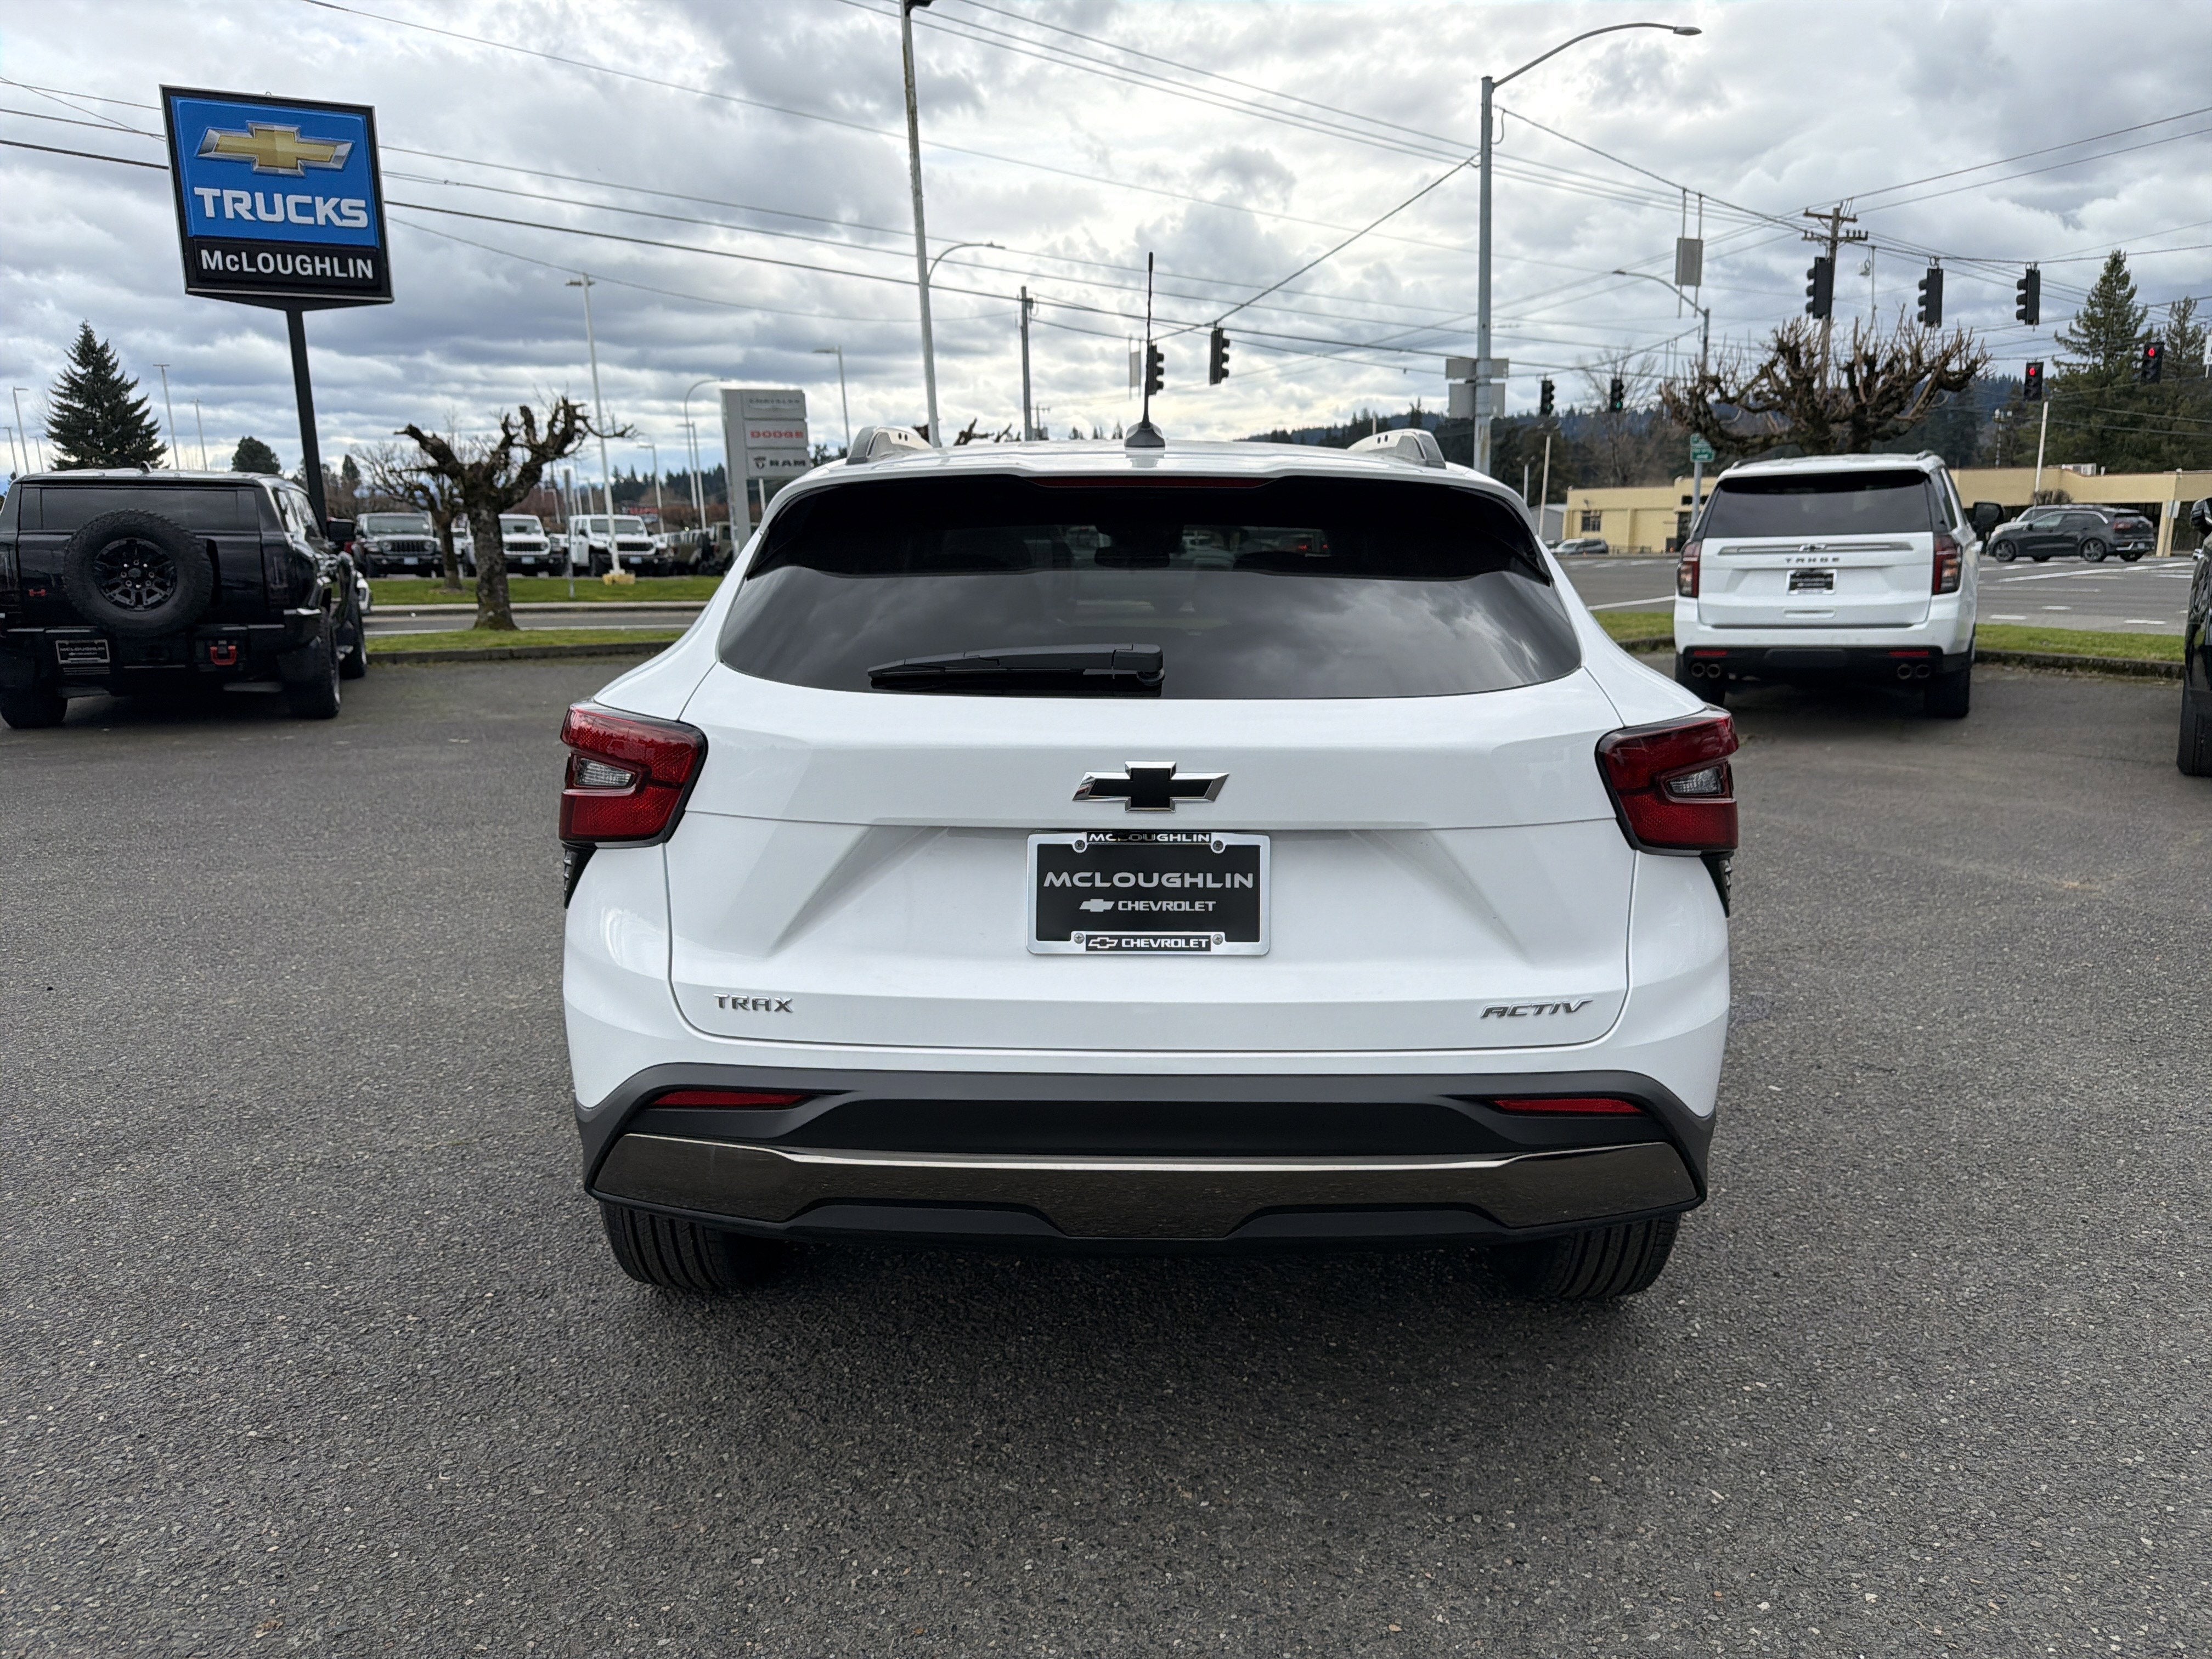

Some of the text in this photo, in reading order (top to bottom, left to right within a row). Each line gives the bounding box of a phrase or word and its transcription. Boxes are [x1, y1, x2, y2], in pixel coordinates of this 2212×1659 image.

[194, 187, 368, 228] TRUCKS
[201, 249, 373, 279] McLOUGHLIN
[751, 430, 804, 438] DODGE
[1043, 871, 1254, 889] MCLOUGHLIN
[1118, 900, 1217, 912] CHEVROLET
[1121, 938, 1209, 949] CHEVROLET
[713, 992, 794, 1013] TRAX
[1480, 998, 1593, 1019] ACTIV
